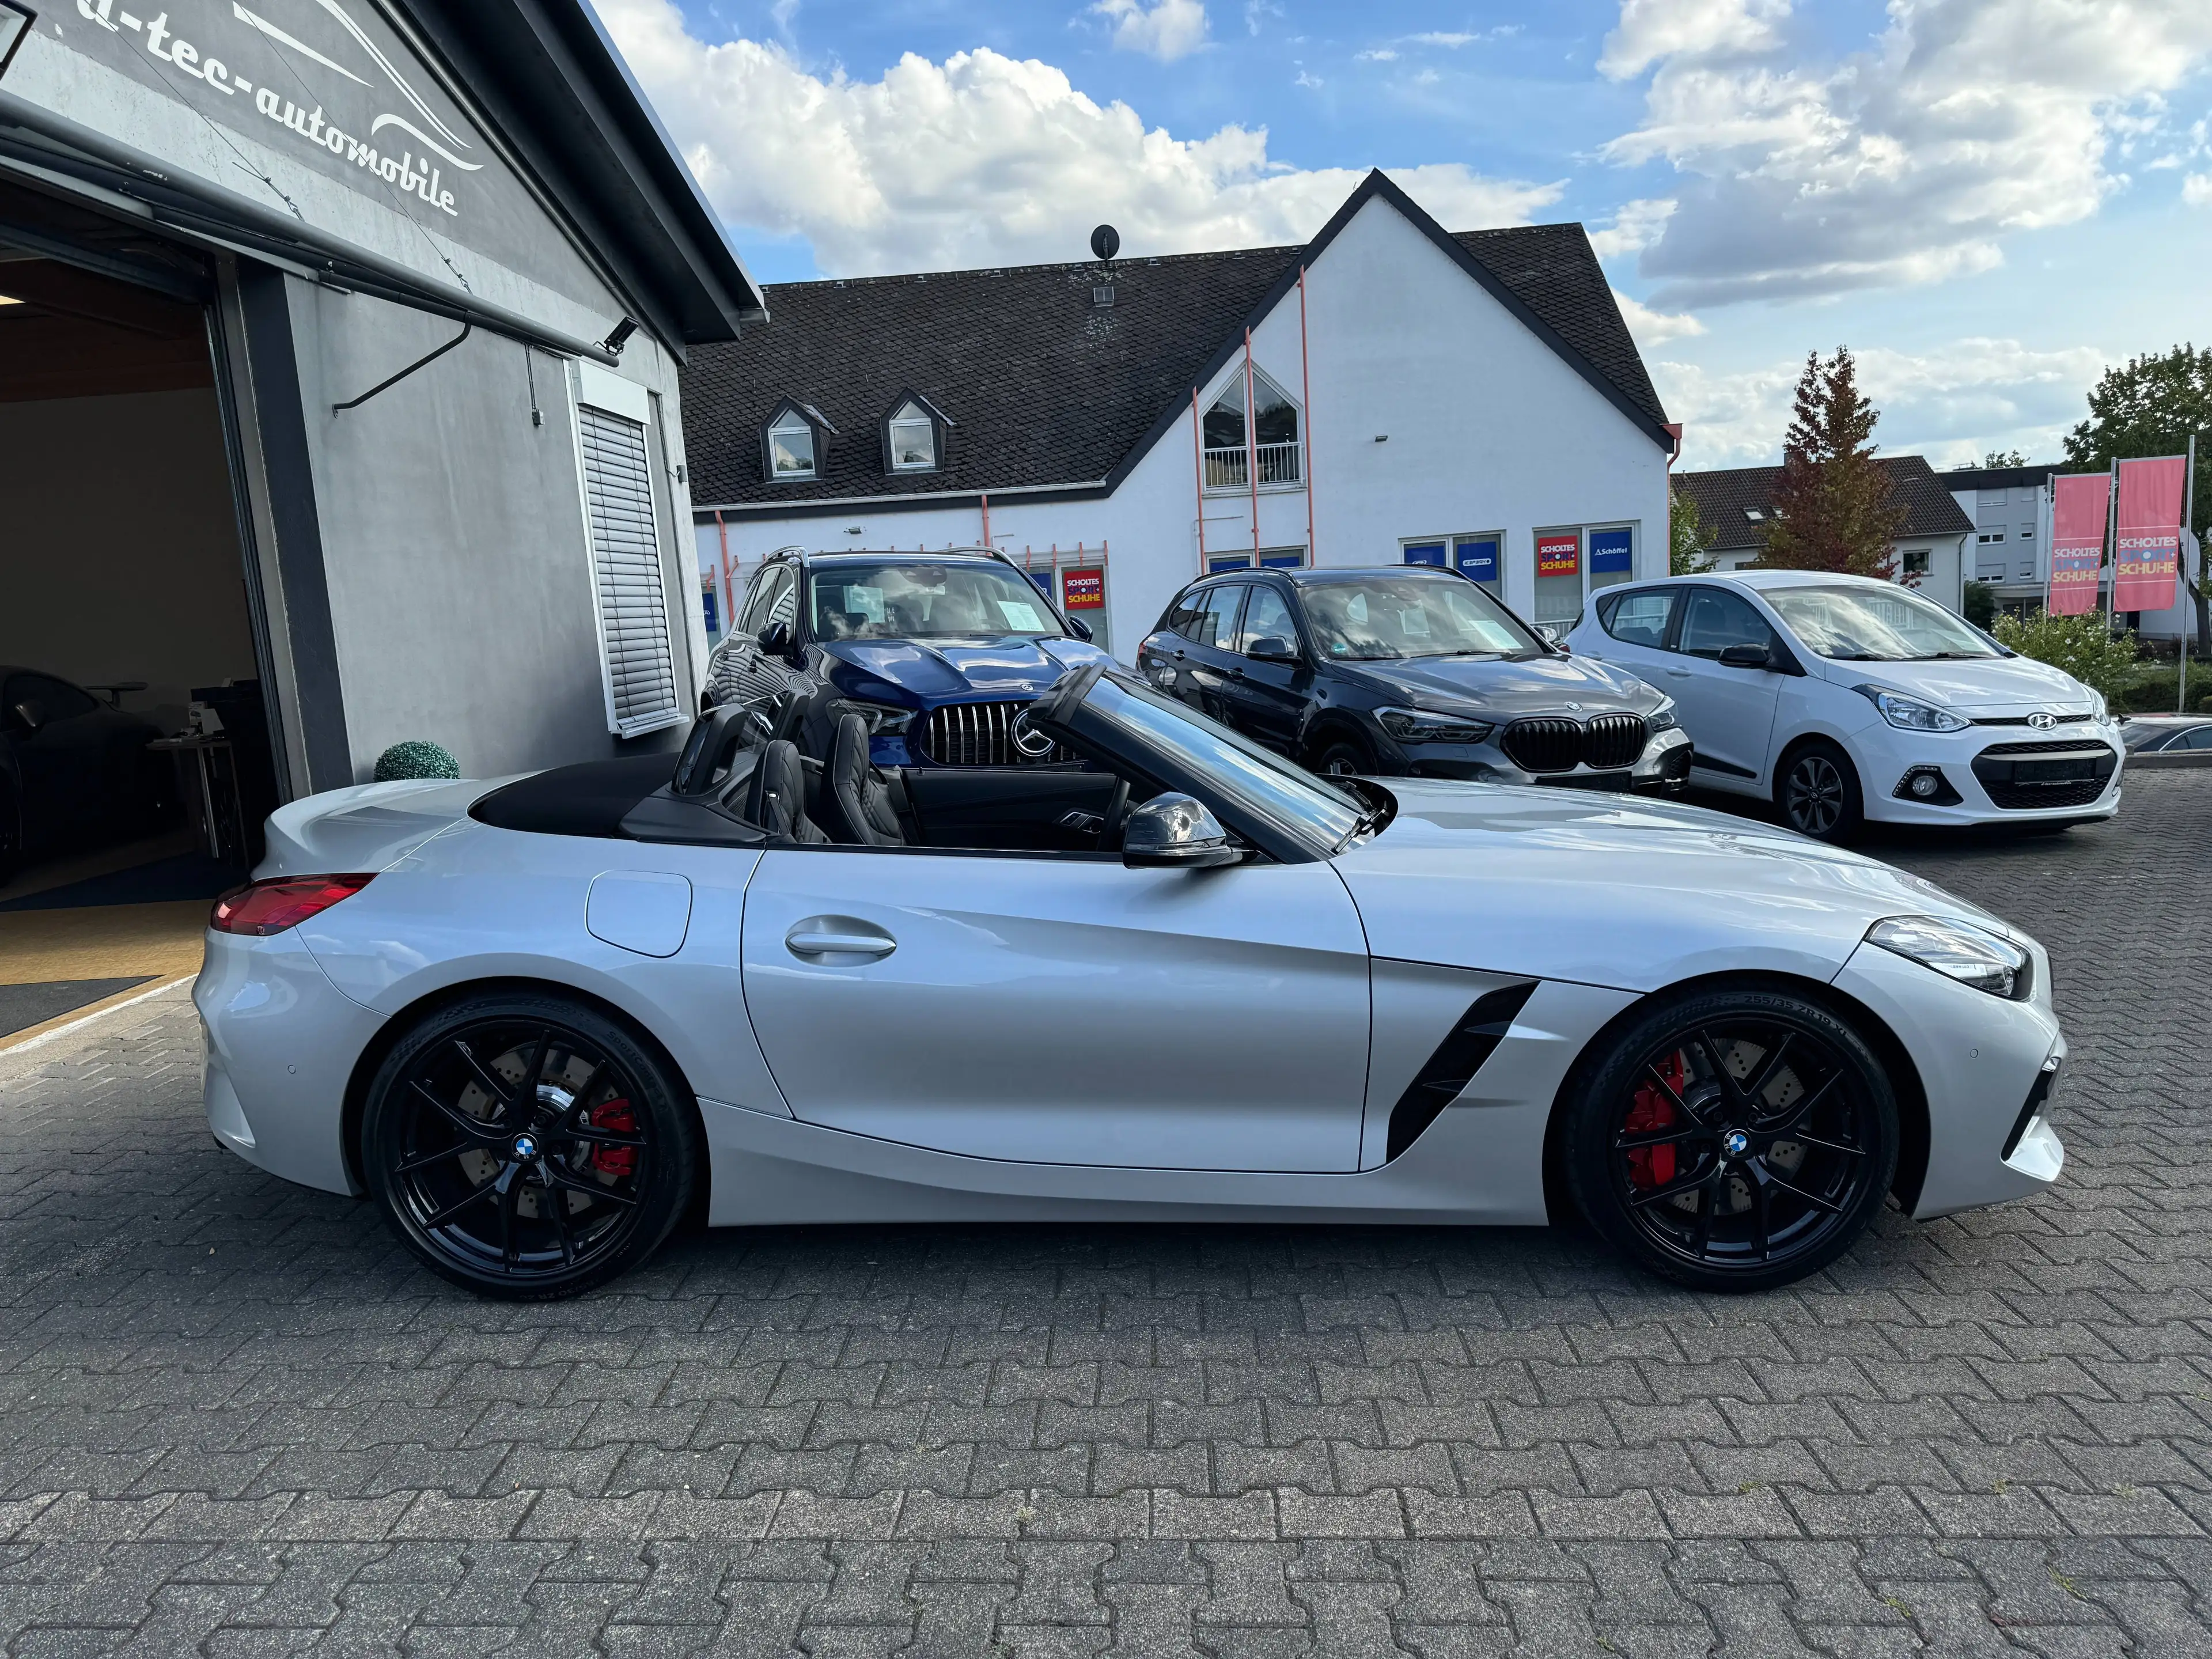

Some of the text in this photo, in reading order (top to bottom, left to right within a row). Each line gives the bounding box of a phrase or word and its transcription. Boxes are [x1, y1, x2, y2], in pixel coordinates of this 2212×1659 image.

[2119, 536, 2177, 548] SCHOLTES
[1540, 544, 1575, 553] SCHOLTES
[2054, 547, 2100, 558] SCHOLTES
[1541, 560, 1575, 570] SCHUHE
[2118, 562, 2175, 575] SCHUHE
[2053, 570, 2098, 582] SCHUHE
[1067, 578, 1100, 586] SCHOLTES
[1068, 594, 1100, 603] SCHUHE
[1744, 995, 1794, 1008] 255/35
